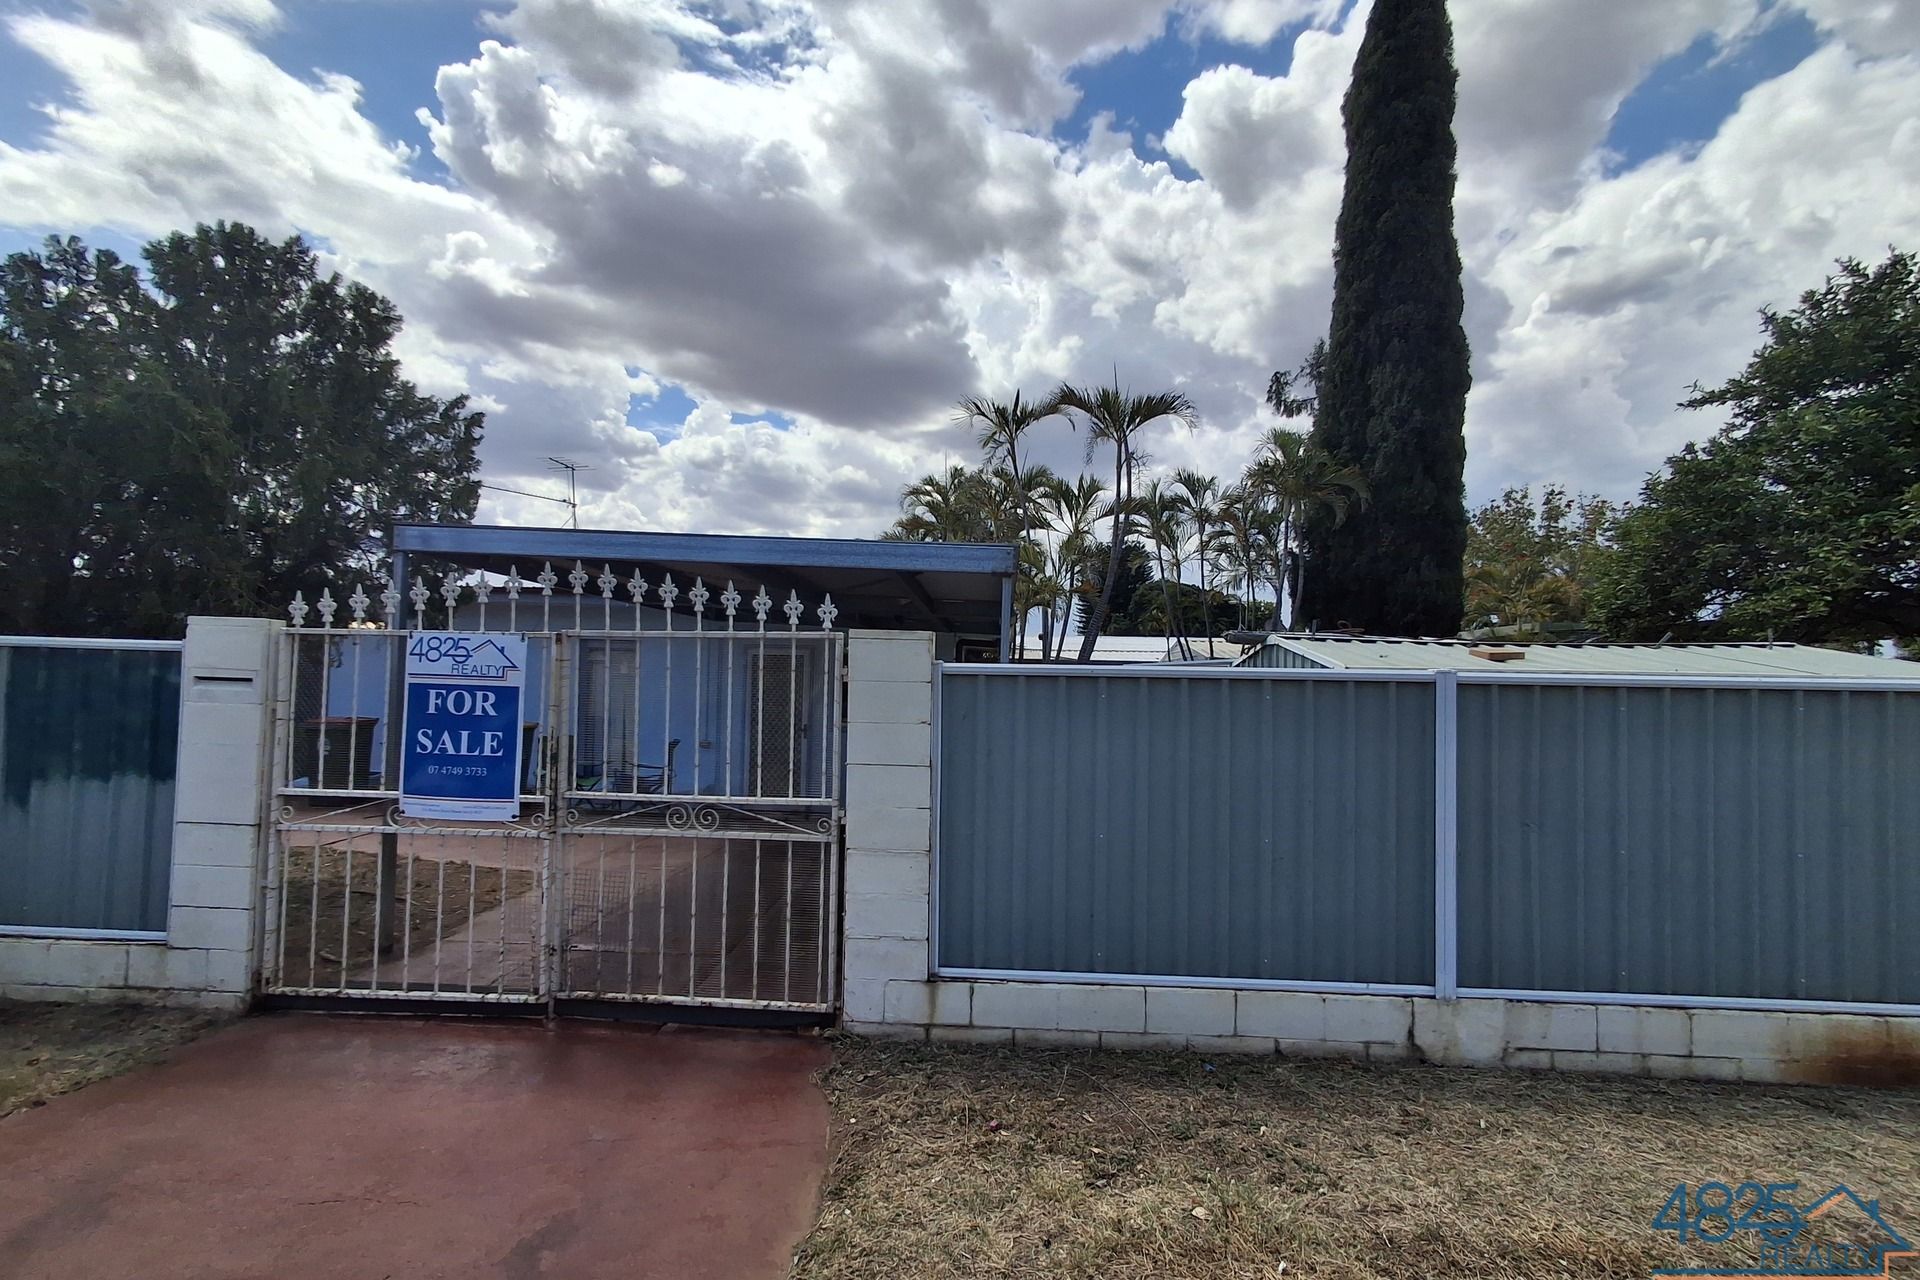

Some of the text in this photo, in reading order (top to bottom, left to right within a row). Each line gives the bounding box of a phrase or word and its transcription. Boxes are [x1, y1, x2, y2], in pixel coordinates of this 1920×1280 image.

[409, 636, 473, 664] 4825
[451, 664, 503, 676] REALTY
[426, 689, 498, 716] FOR
[416, 728, 504, 757] SALE
[428, 765, 487, 777] 07 4749 3733
